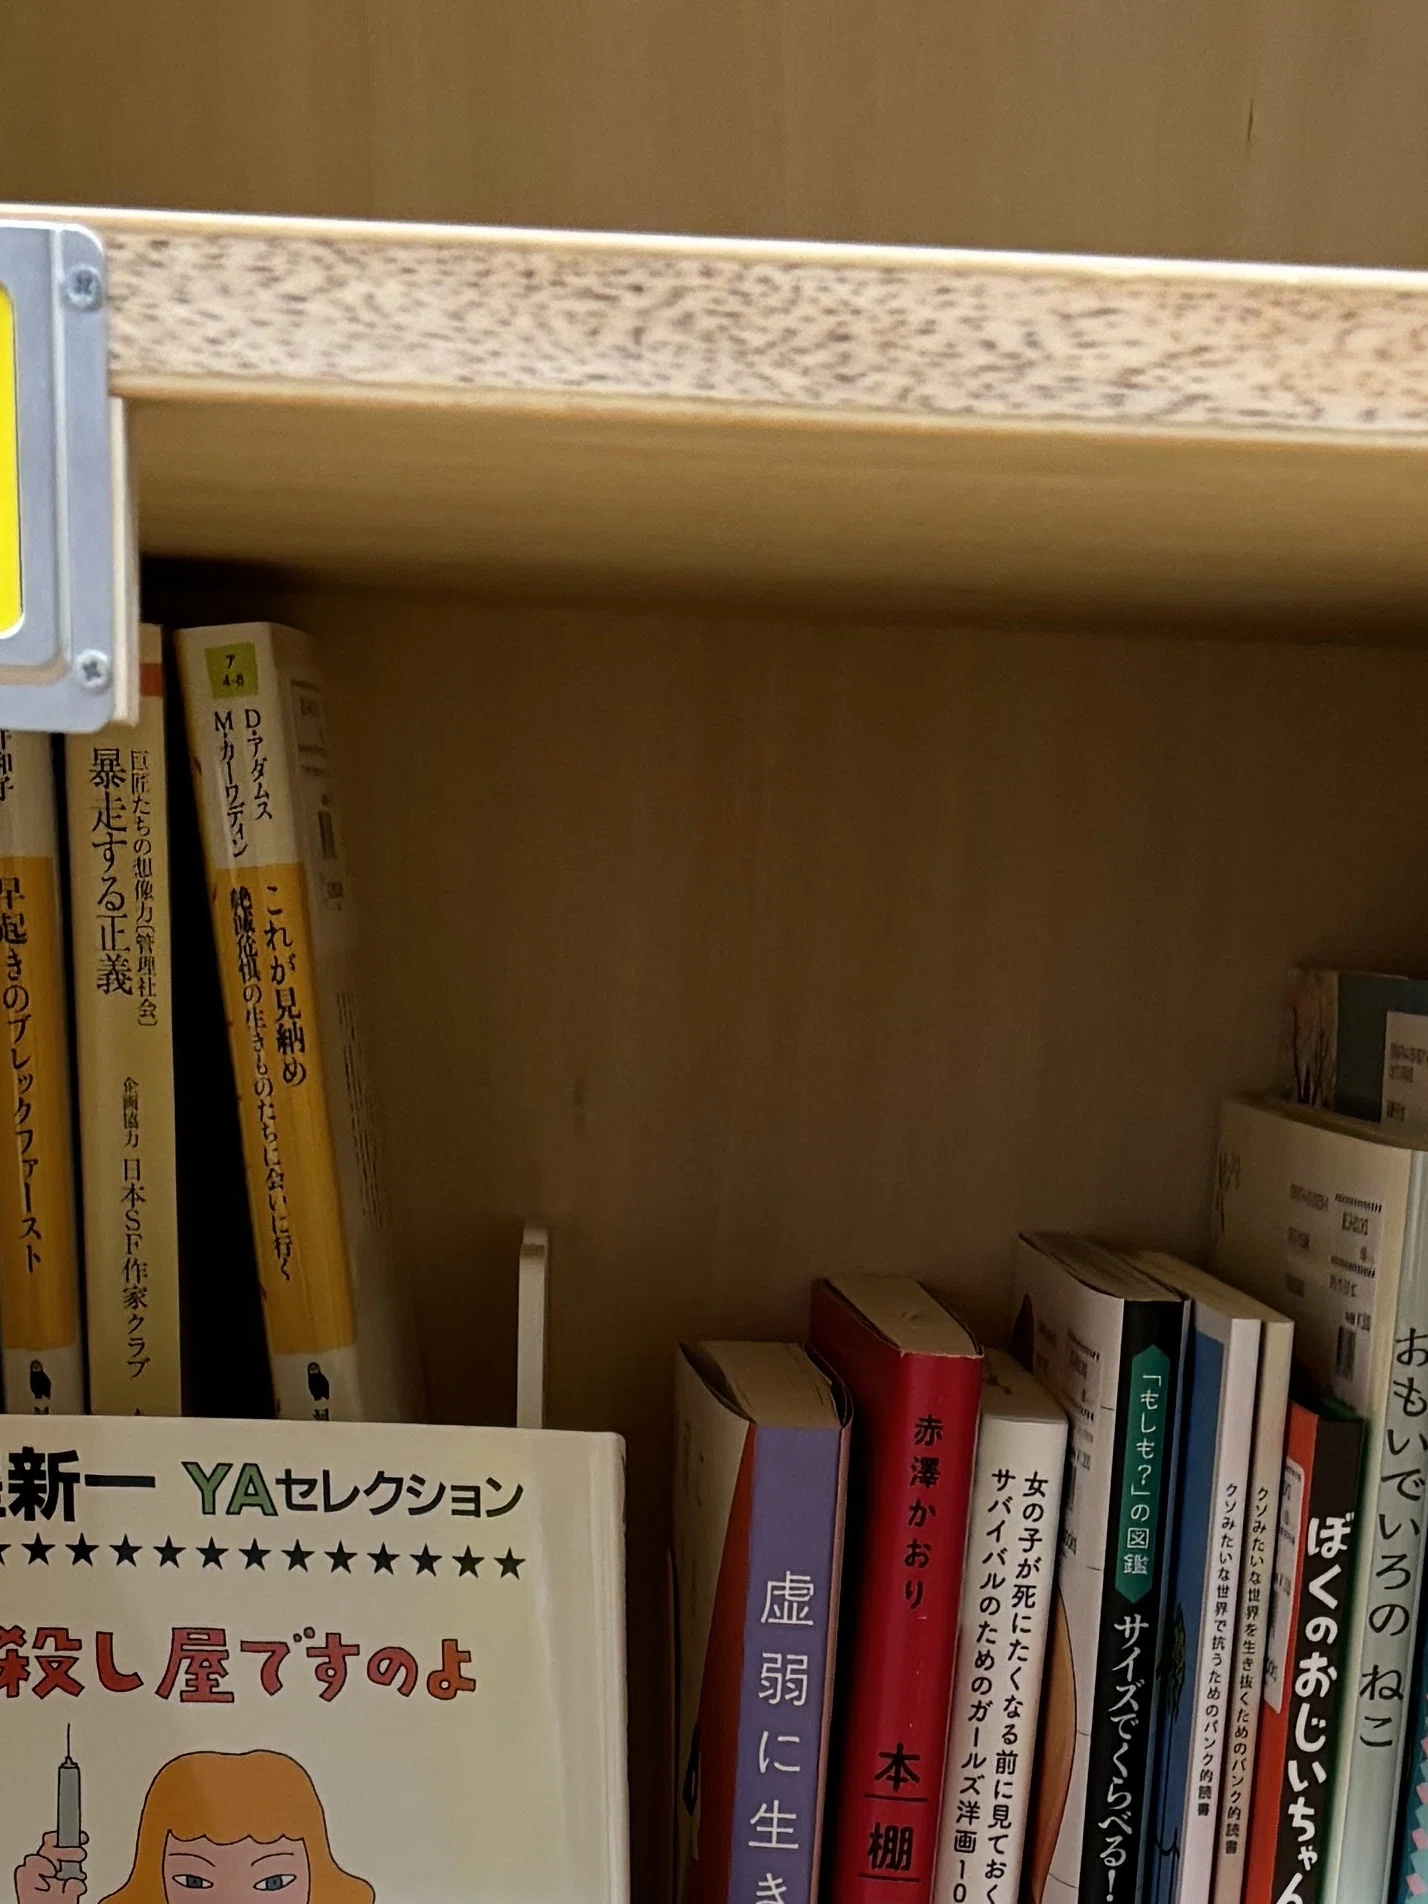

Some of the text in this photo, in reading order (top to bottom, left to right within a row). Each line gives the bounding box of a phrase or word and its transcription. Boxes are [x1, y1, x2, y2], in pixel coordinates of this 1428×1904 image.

[88, 746, 134, 996] 暴走する正義
[263, 885, 308, 1086] これが見納め
[121, 1156, 151, 1379] 日本SF作家クラブ
[181, 1460, 524, 1520] YAセレクション
[903, 1412, 944, 1612] 赤澤かおり
[1359, 1664, 1405, 1748] ねこ
